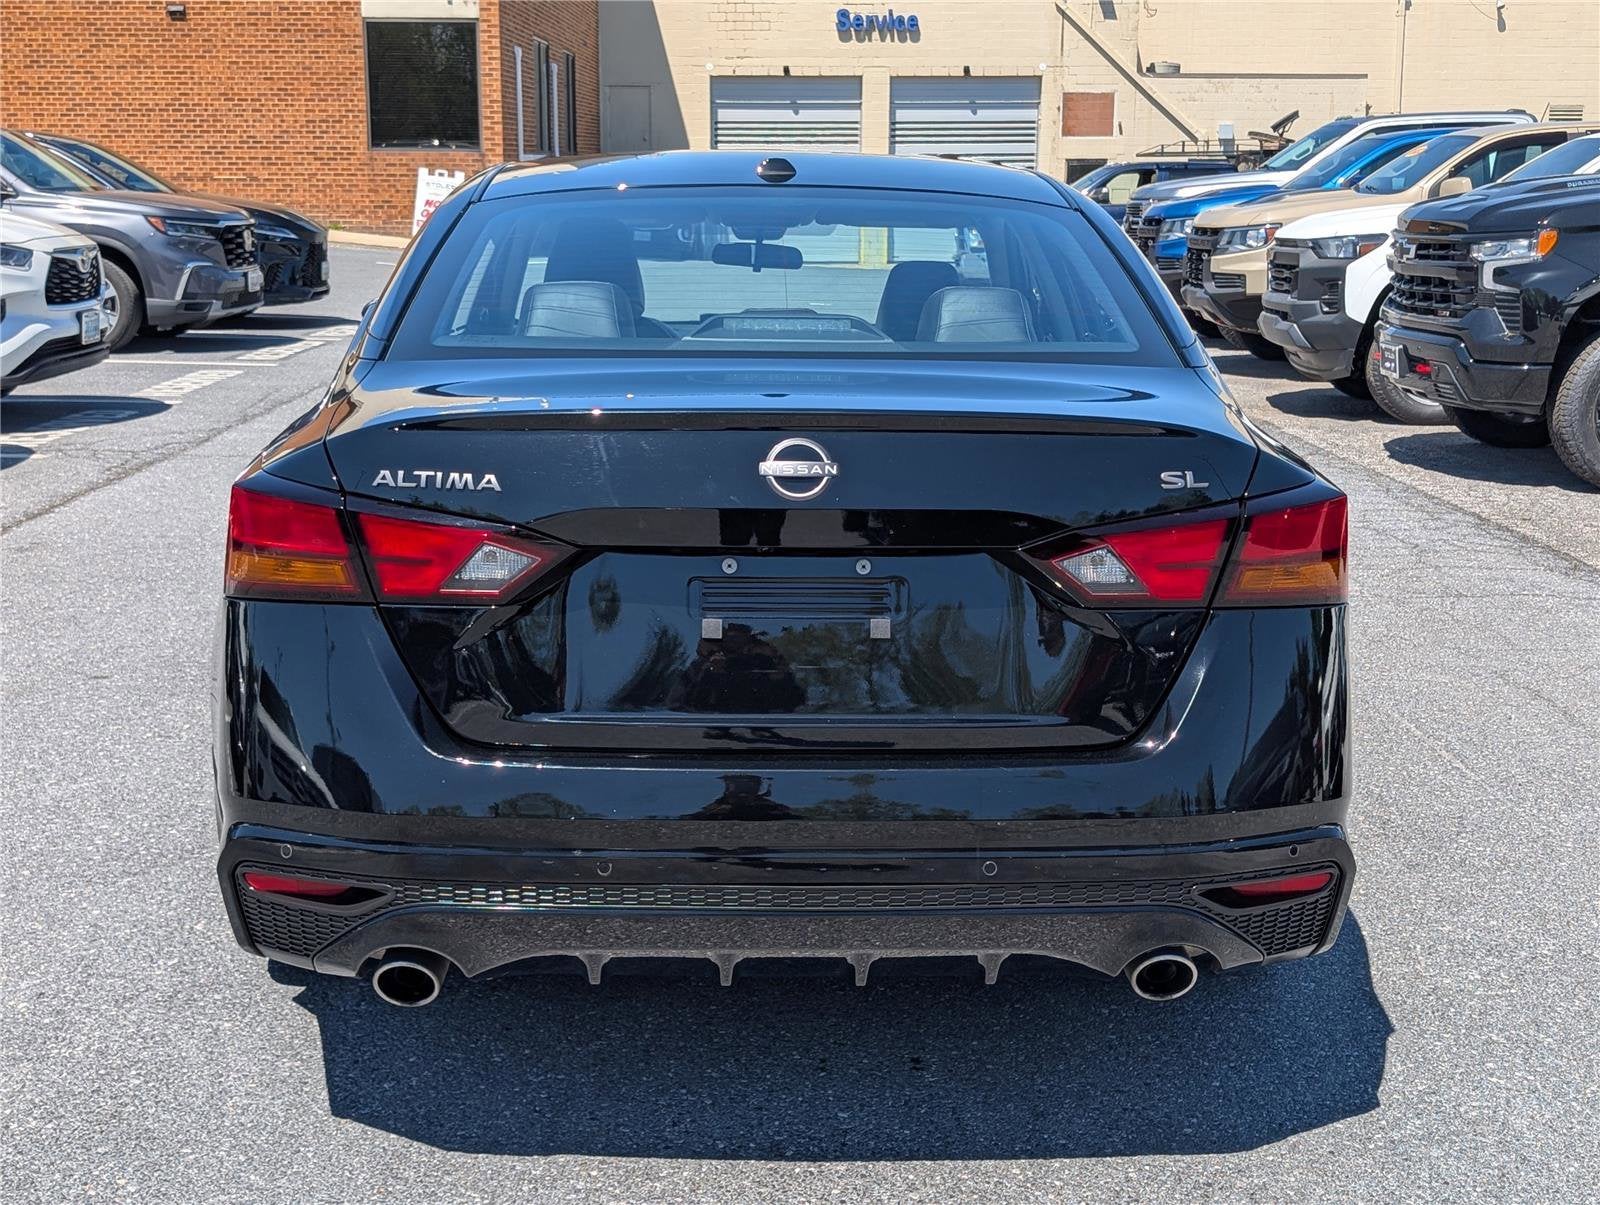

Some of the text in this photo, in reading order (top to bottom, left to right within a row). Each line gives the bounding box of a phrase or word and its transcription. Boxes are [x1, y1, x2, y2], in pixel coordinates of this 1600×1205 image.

[836, 9, 919, 32] Service
[760, 464, 837, 475] NISSAN
[1160, 470, 1209, 490] SL
[372, 469, 502, 492] ALTIMA
